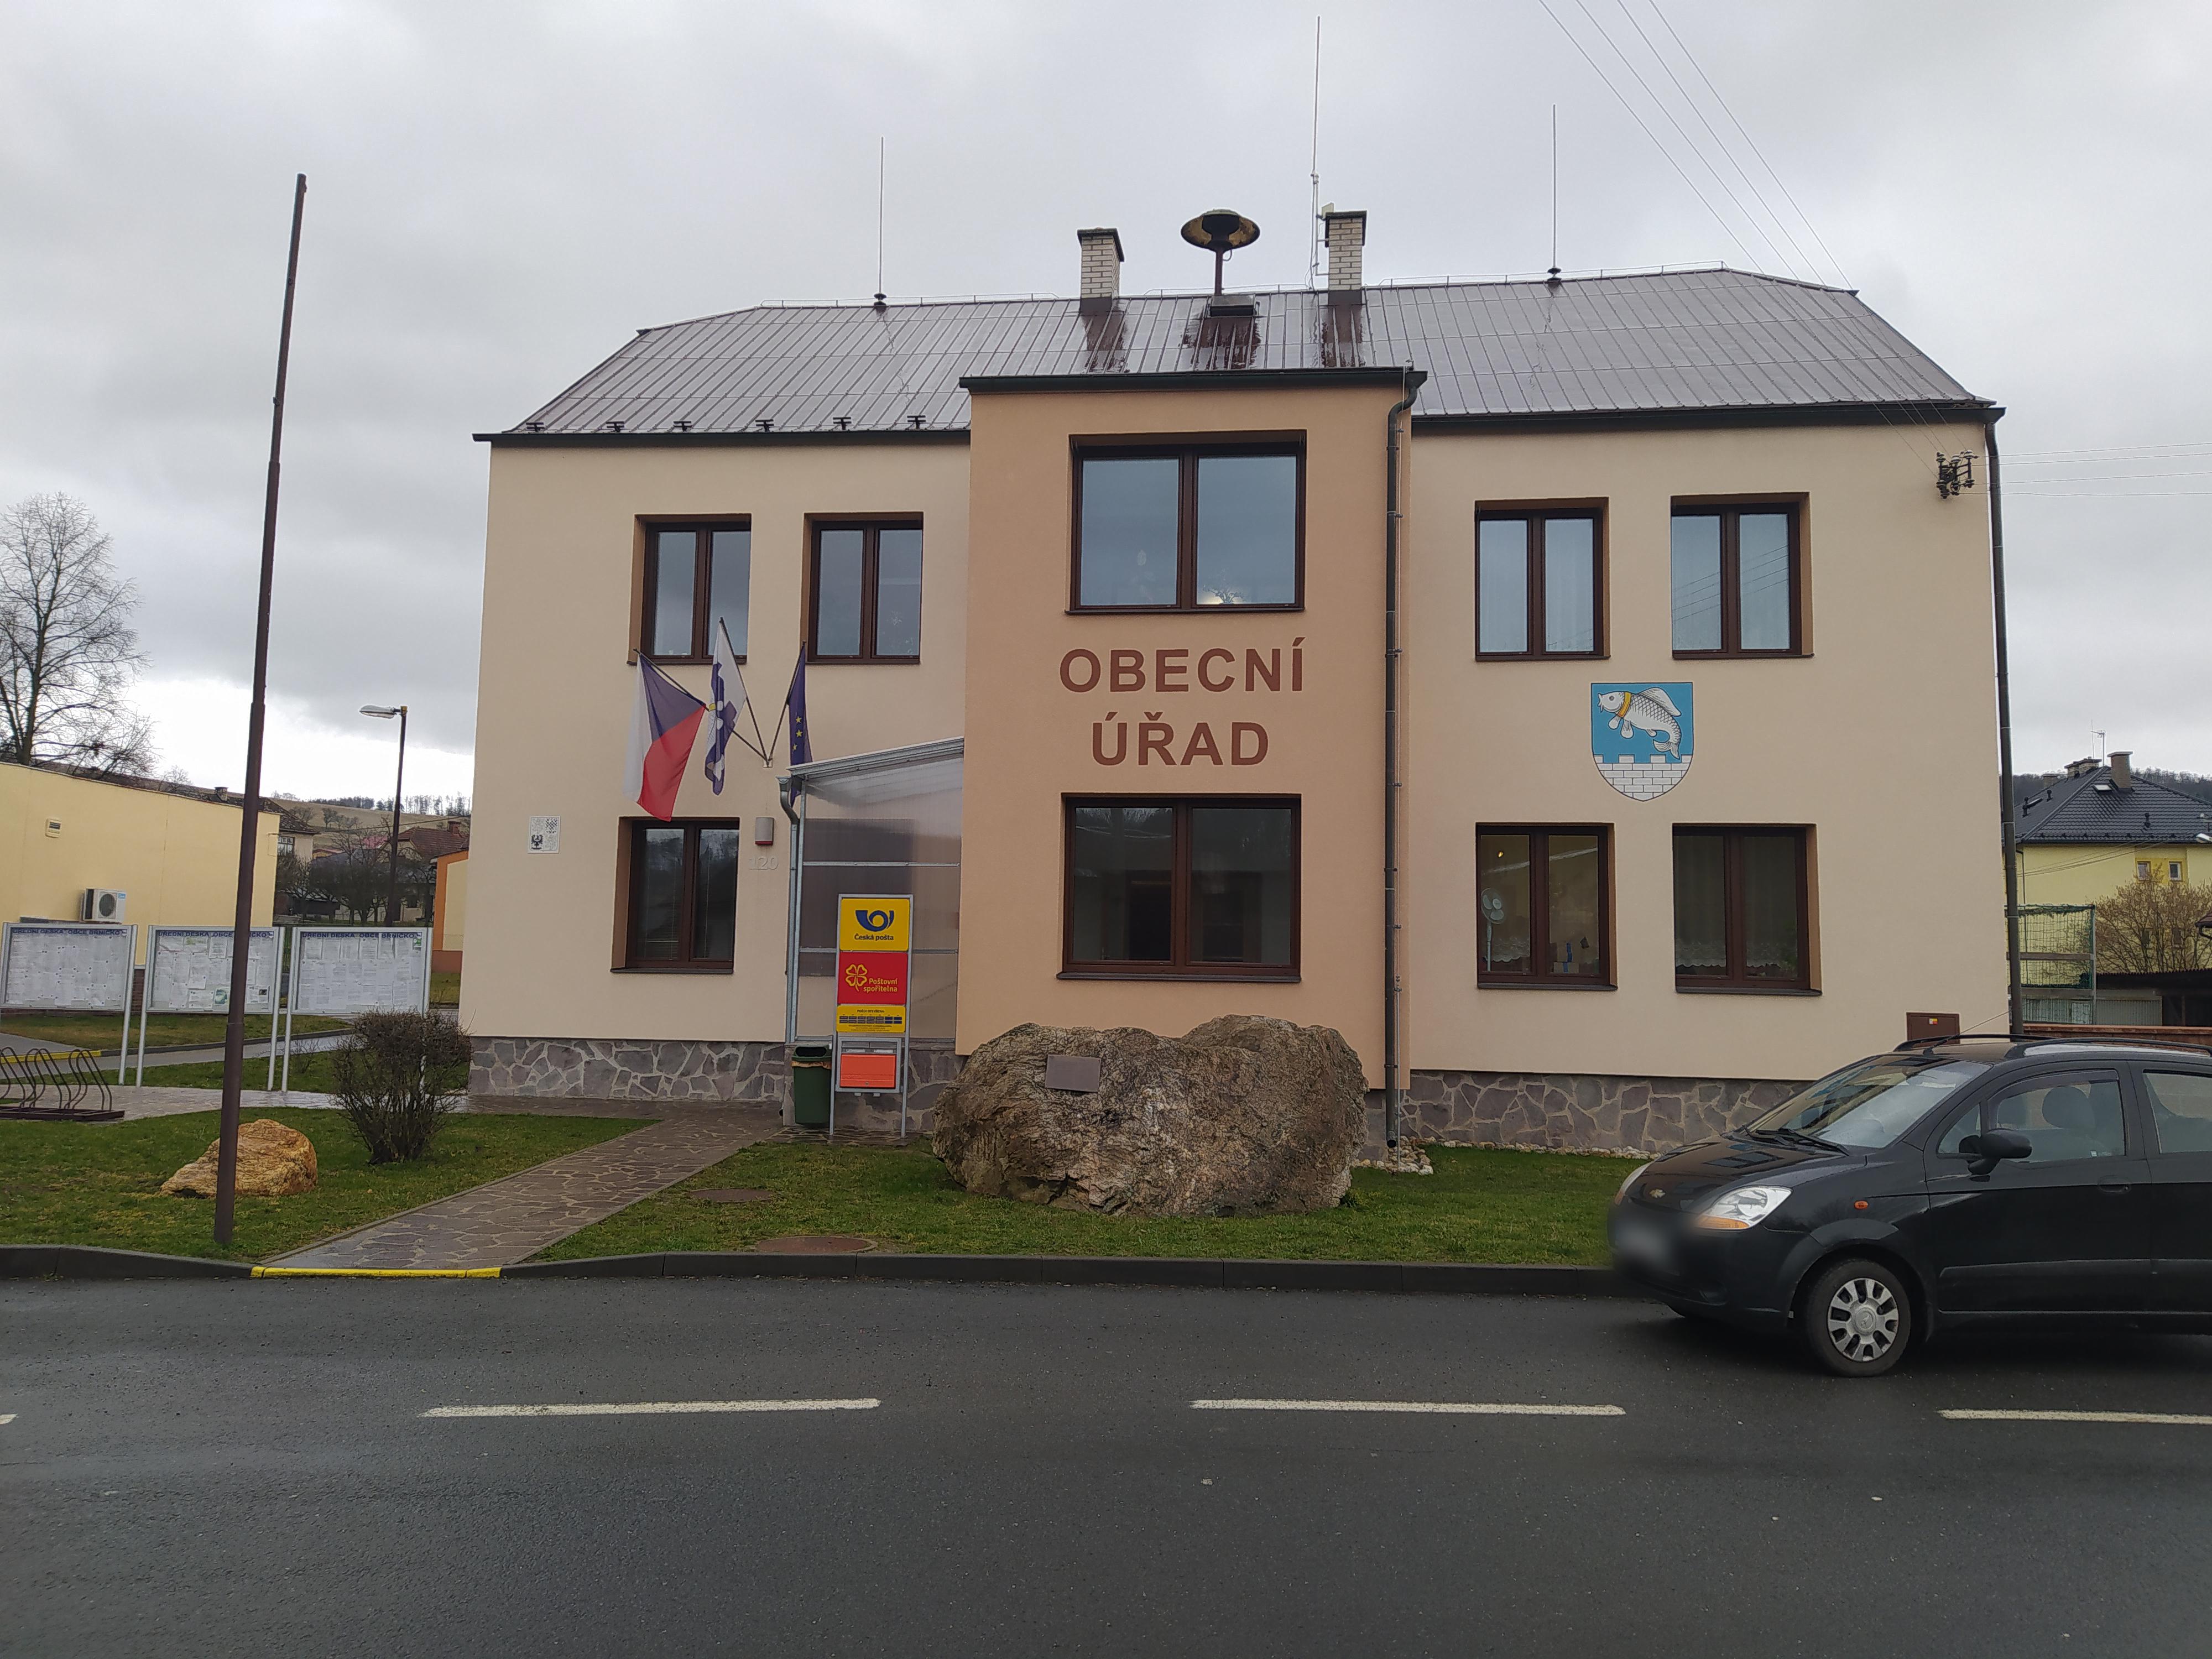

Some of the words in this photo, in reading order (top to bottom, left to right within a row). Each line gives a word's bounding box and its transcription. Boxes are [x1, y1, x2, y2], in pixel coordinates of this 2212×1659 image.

[1060, 637, 1306, 693] OBECNÍ
[1092, 711, 1269, 766] ÚŘAD
[748, 857, 779, 870] 120
[863, 985, 898, 993] spořitelna
